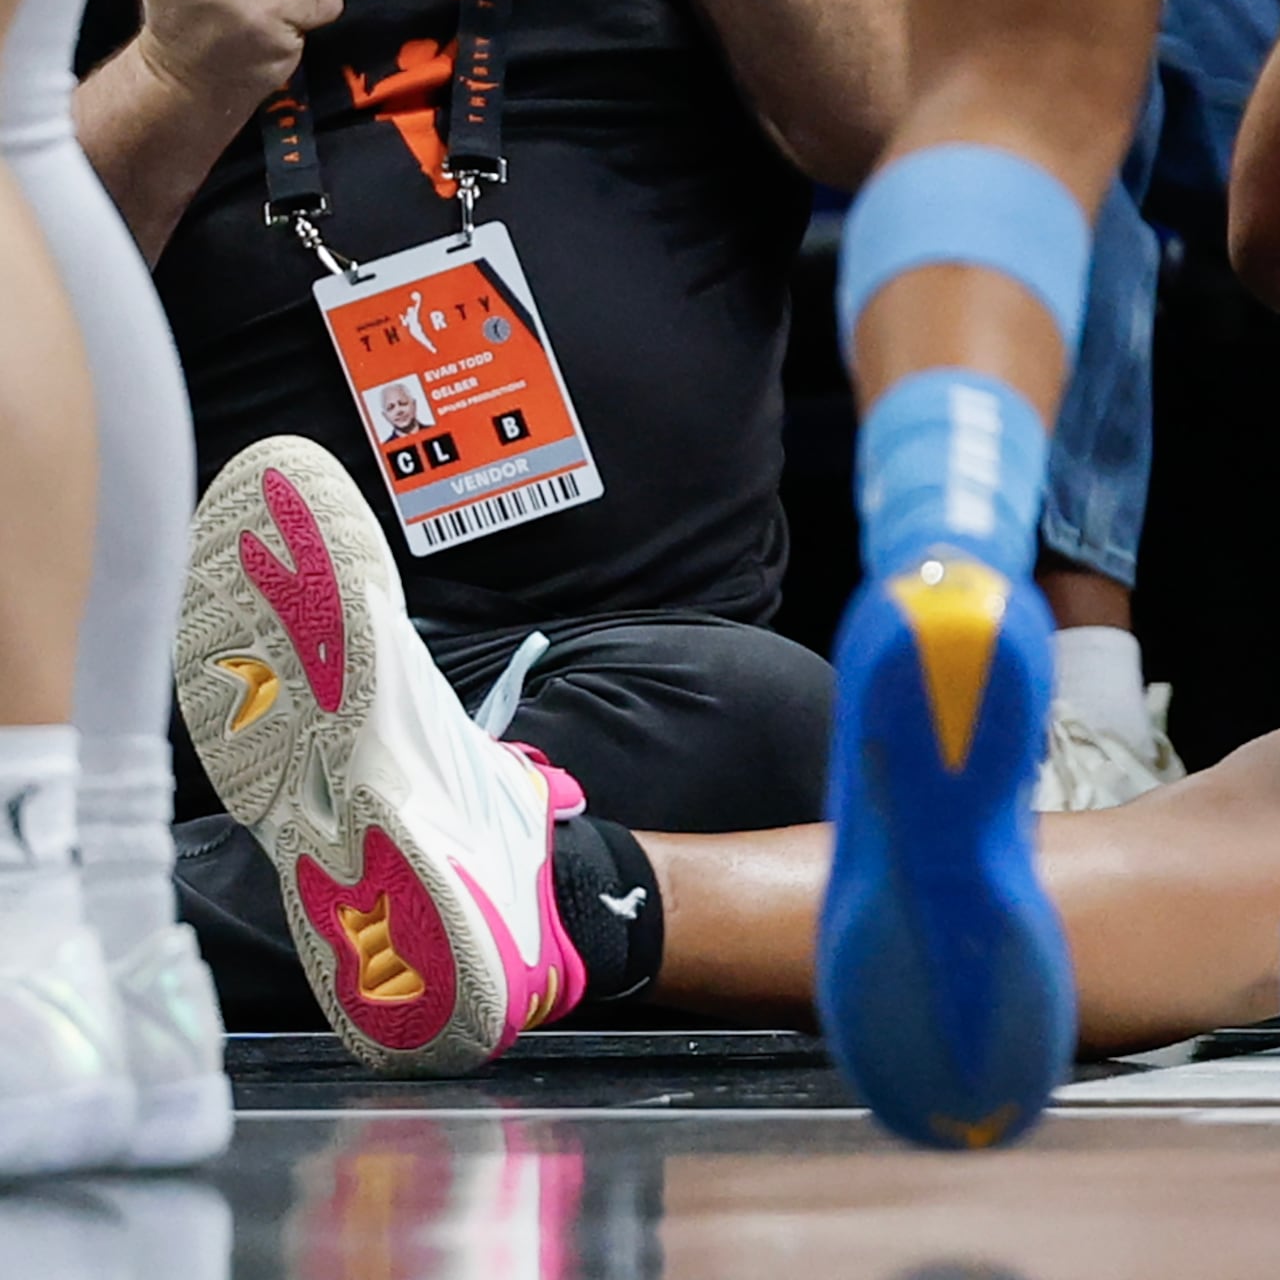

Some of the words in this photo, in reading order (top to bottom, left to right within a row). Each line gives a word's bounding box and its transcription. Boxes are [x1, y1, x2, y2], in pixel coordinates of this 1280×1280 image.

[424, 362, 458, 383] EVAN
[459, 351, 494, 370] TODD
[397, 452, 415, 474] C
[432, 441, 450, 462] L
[501, 416, 521, 439] B
[450, 458, 530, 495] VENDOR
